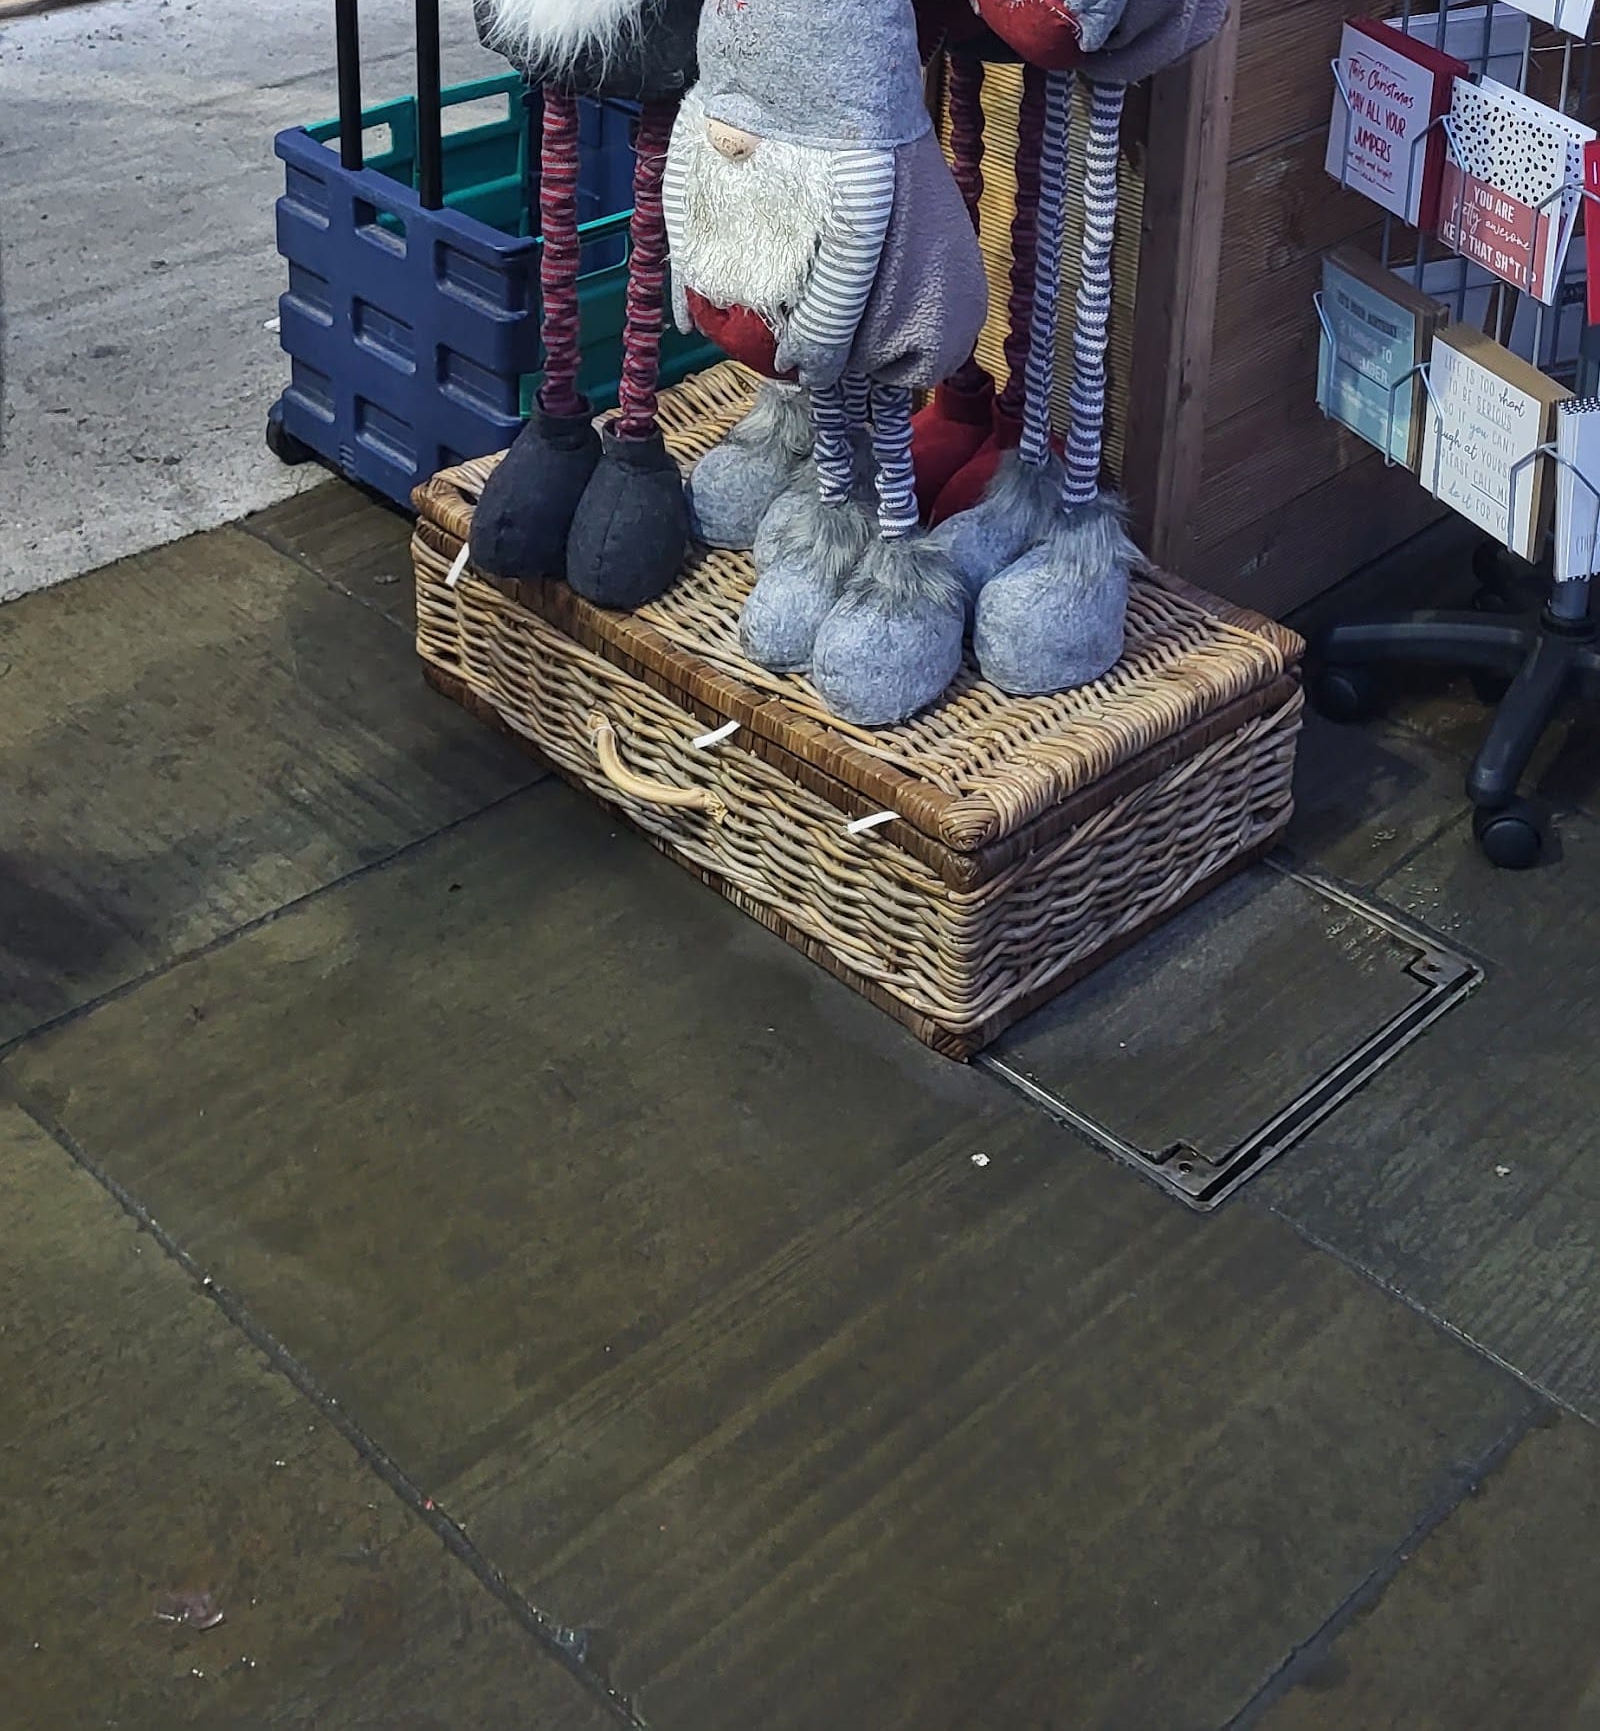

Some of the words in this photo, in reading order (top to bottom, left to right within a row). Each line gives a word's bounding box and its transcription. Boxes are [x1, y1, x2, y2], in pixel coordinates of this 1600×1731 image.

[1348, 58, 1366, 82] This
[1368, 69, 1414, 109] Christmas
[1348, 87, 1365, 114] MAY
[1366, 99, 1381, 125] ALL
[1385, 108, 1407, 140] YOUR
[1354, 126, 1392, 163] JUMPERS
[1451, 196, 1482, 234] petty
[1485, 220, 1531, 251] awesome
[1474, 185, 1493, 211] YOU
[1495, 198, 1515, 224] ARE
[1443, 220, 1467, 247] KEP
[1469, 234, 1494, 263] THAT
[1449, 376, 1458, 395] TO
[1463, 386, 1473, 406] BE
[1477, 395, 1512, 432] SERIOUS
[1466, 366, 1475, 385] IS
[1480, 374, 1495, 397] TOO
[1499, 387, 1526, 418] short
[1434, 416, 1461, 451] lugh
[1464, 443, 1477, 460] at
[1481, 448, 1513, 482] YOURS
[1469, 422, 1489, 440] you
[1474, 469, 1492, 494] CALL
[1475, 498, 1490, 520] FOR
[1496, 511, 1506, 532] YO
